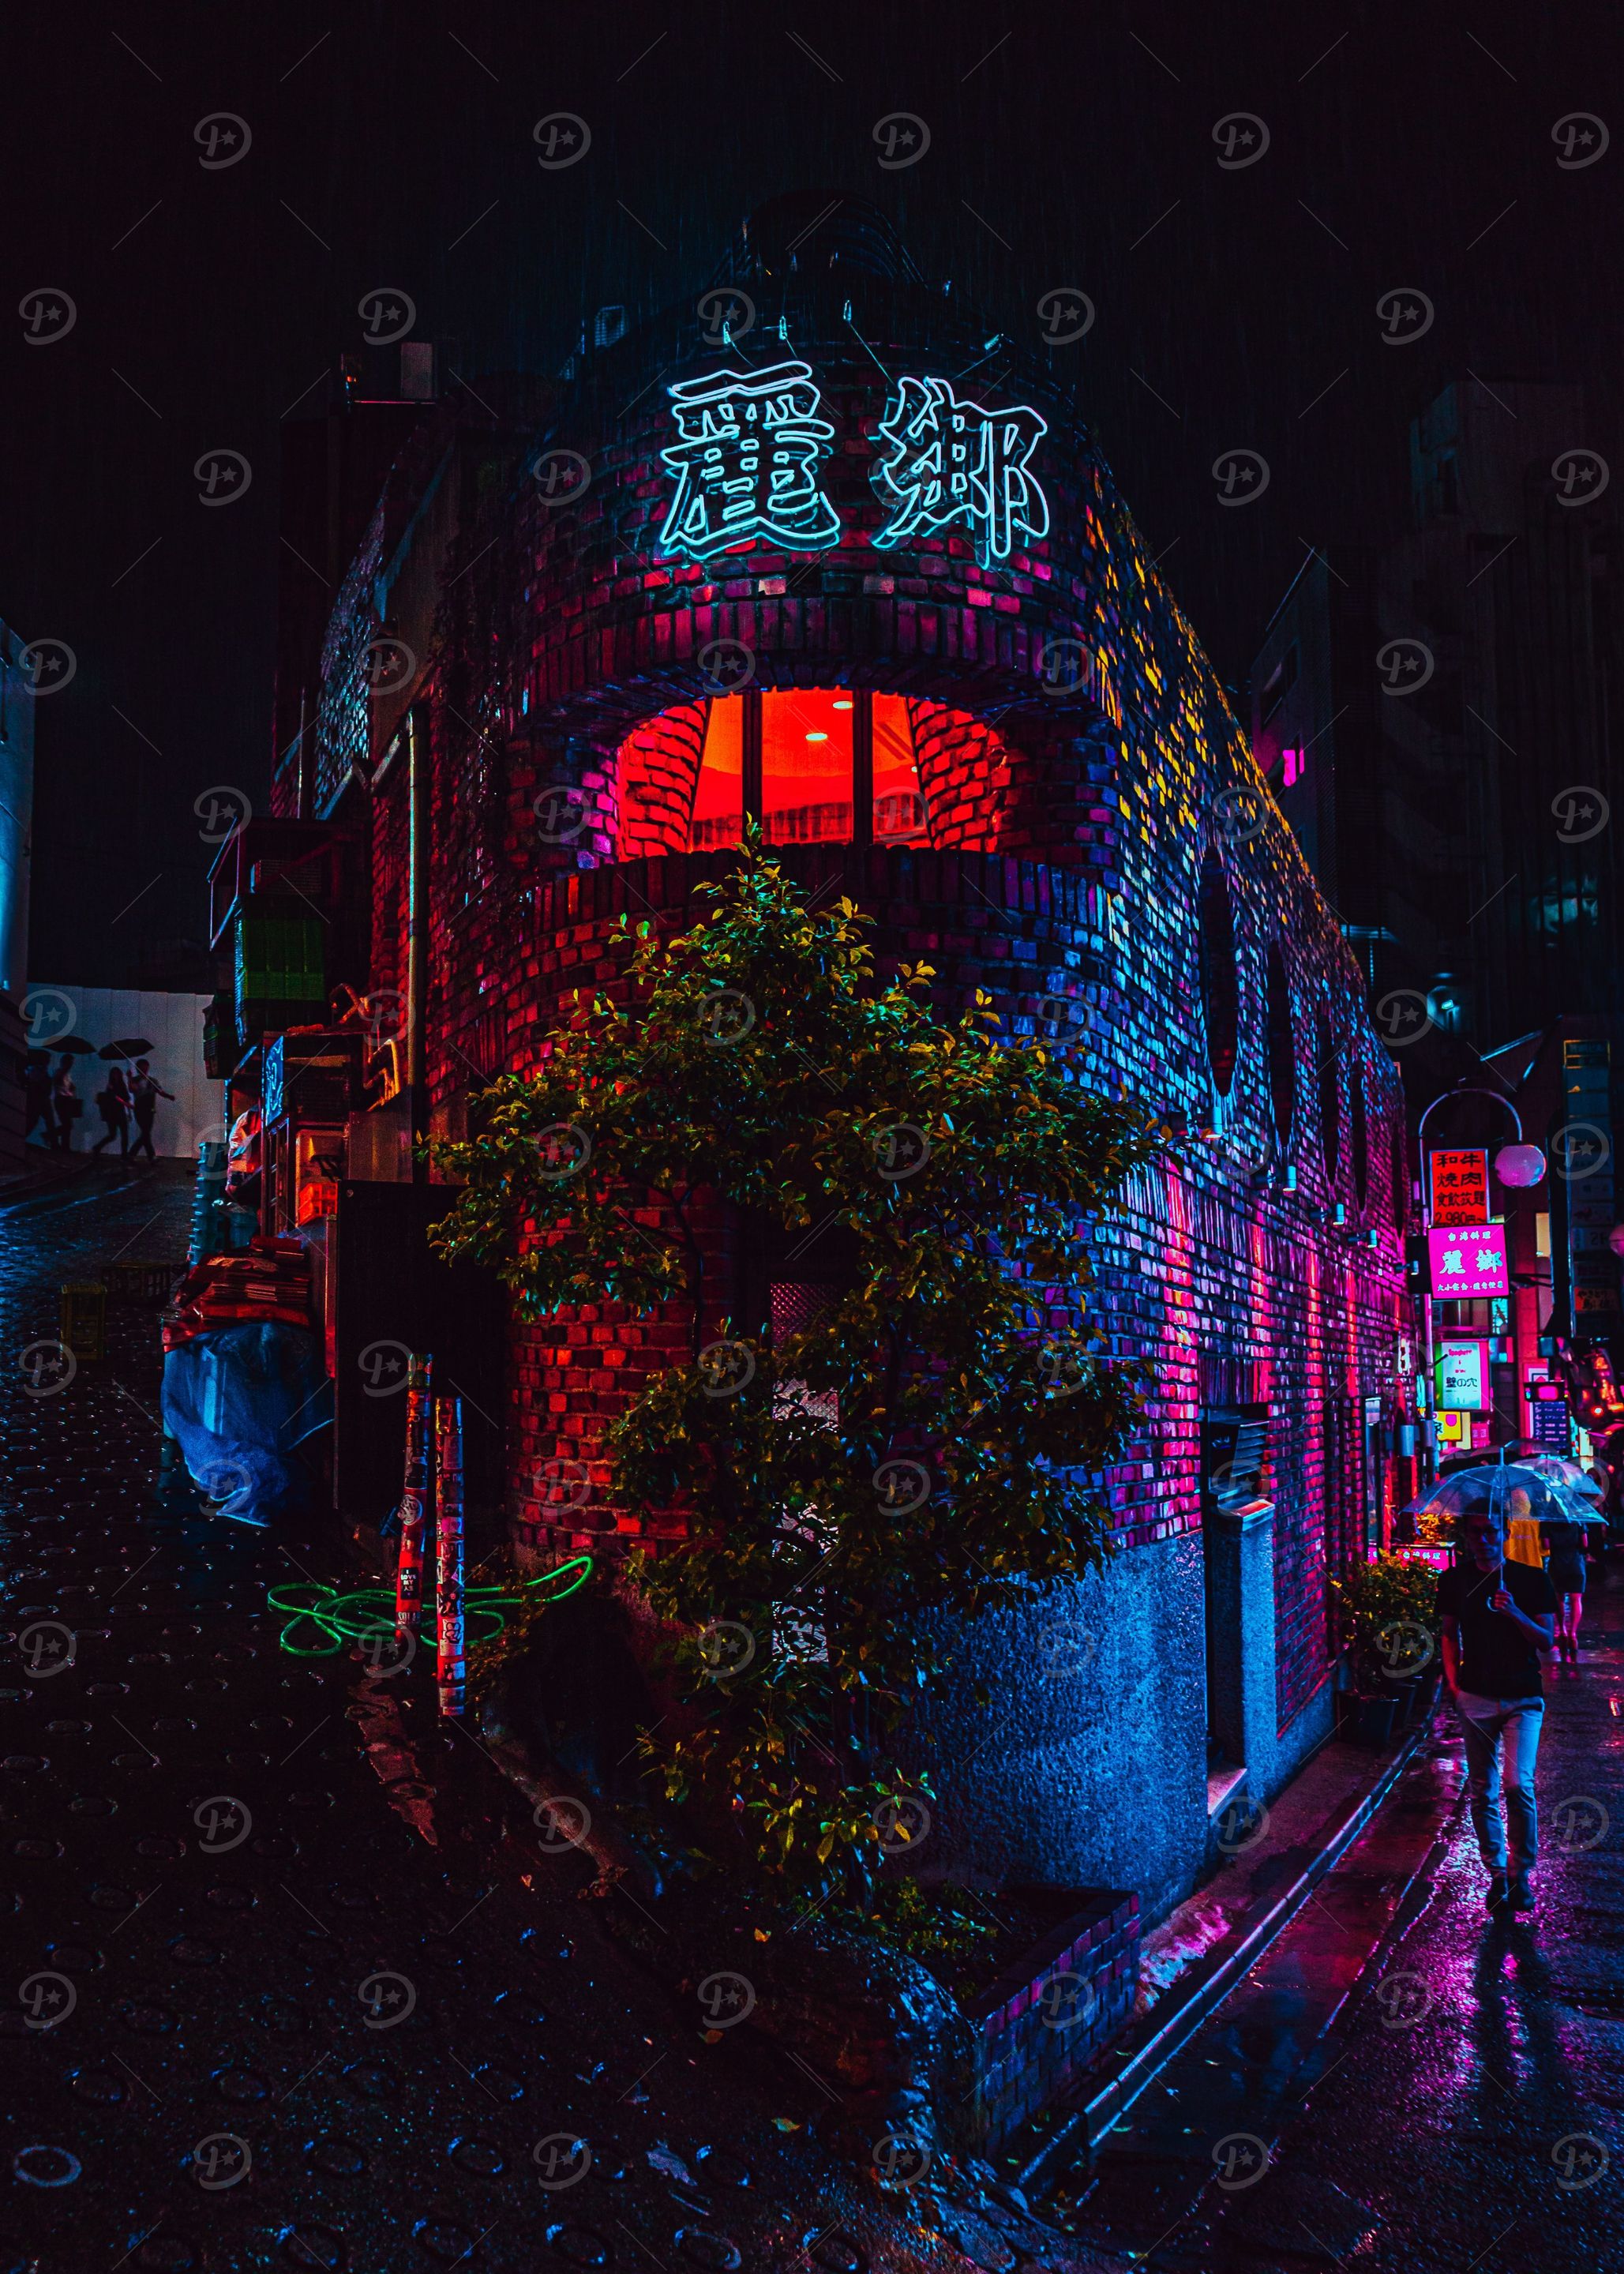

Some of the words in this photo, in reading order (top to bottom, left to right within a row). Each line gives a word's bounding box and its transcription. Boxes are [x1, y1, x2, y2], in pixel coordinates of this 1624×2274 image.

[1436, 1154, 1481, 1168] 和牛
[1436, 1191, 1485, 1207] 食飲放題
[1446, 1376, 1478, 1388] 壁の穴
